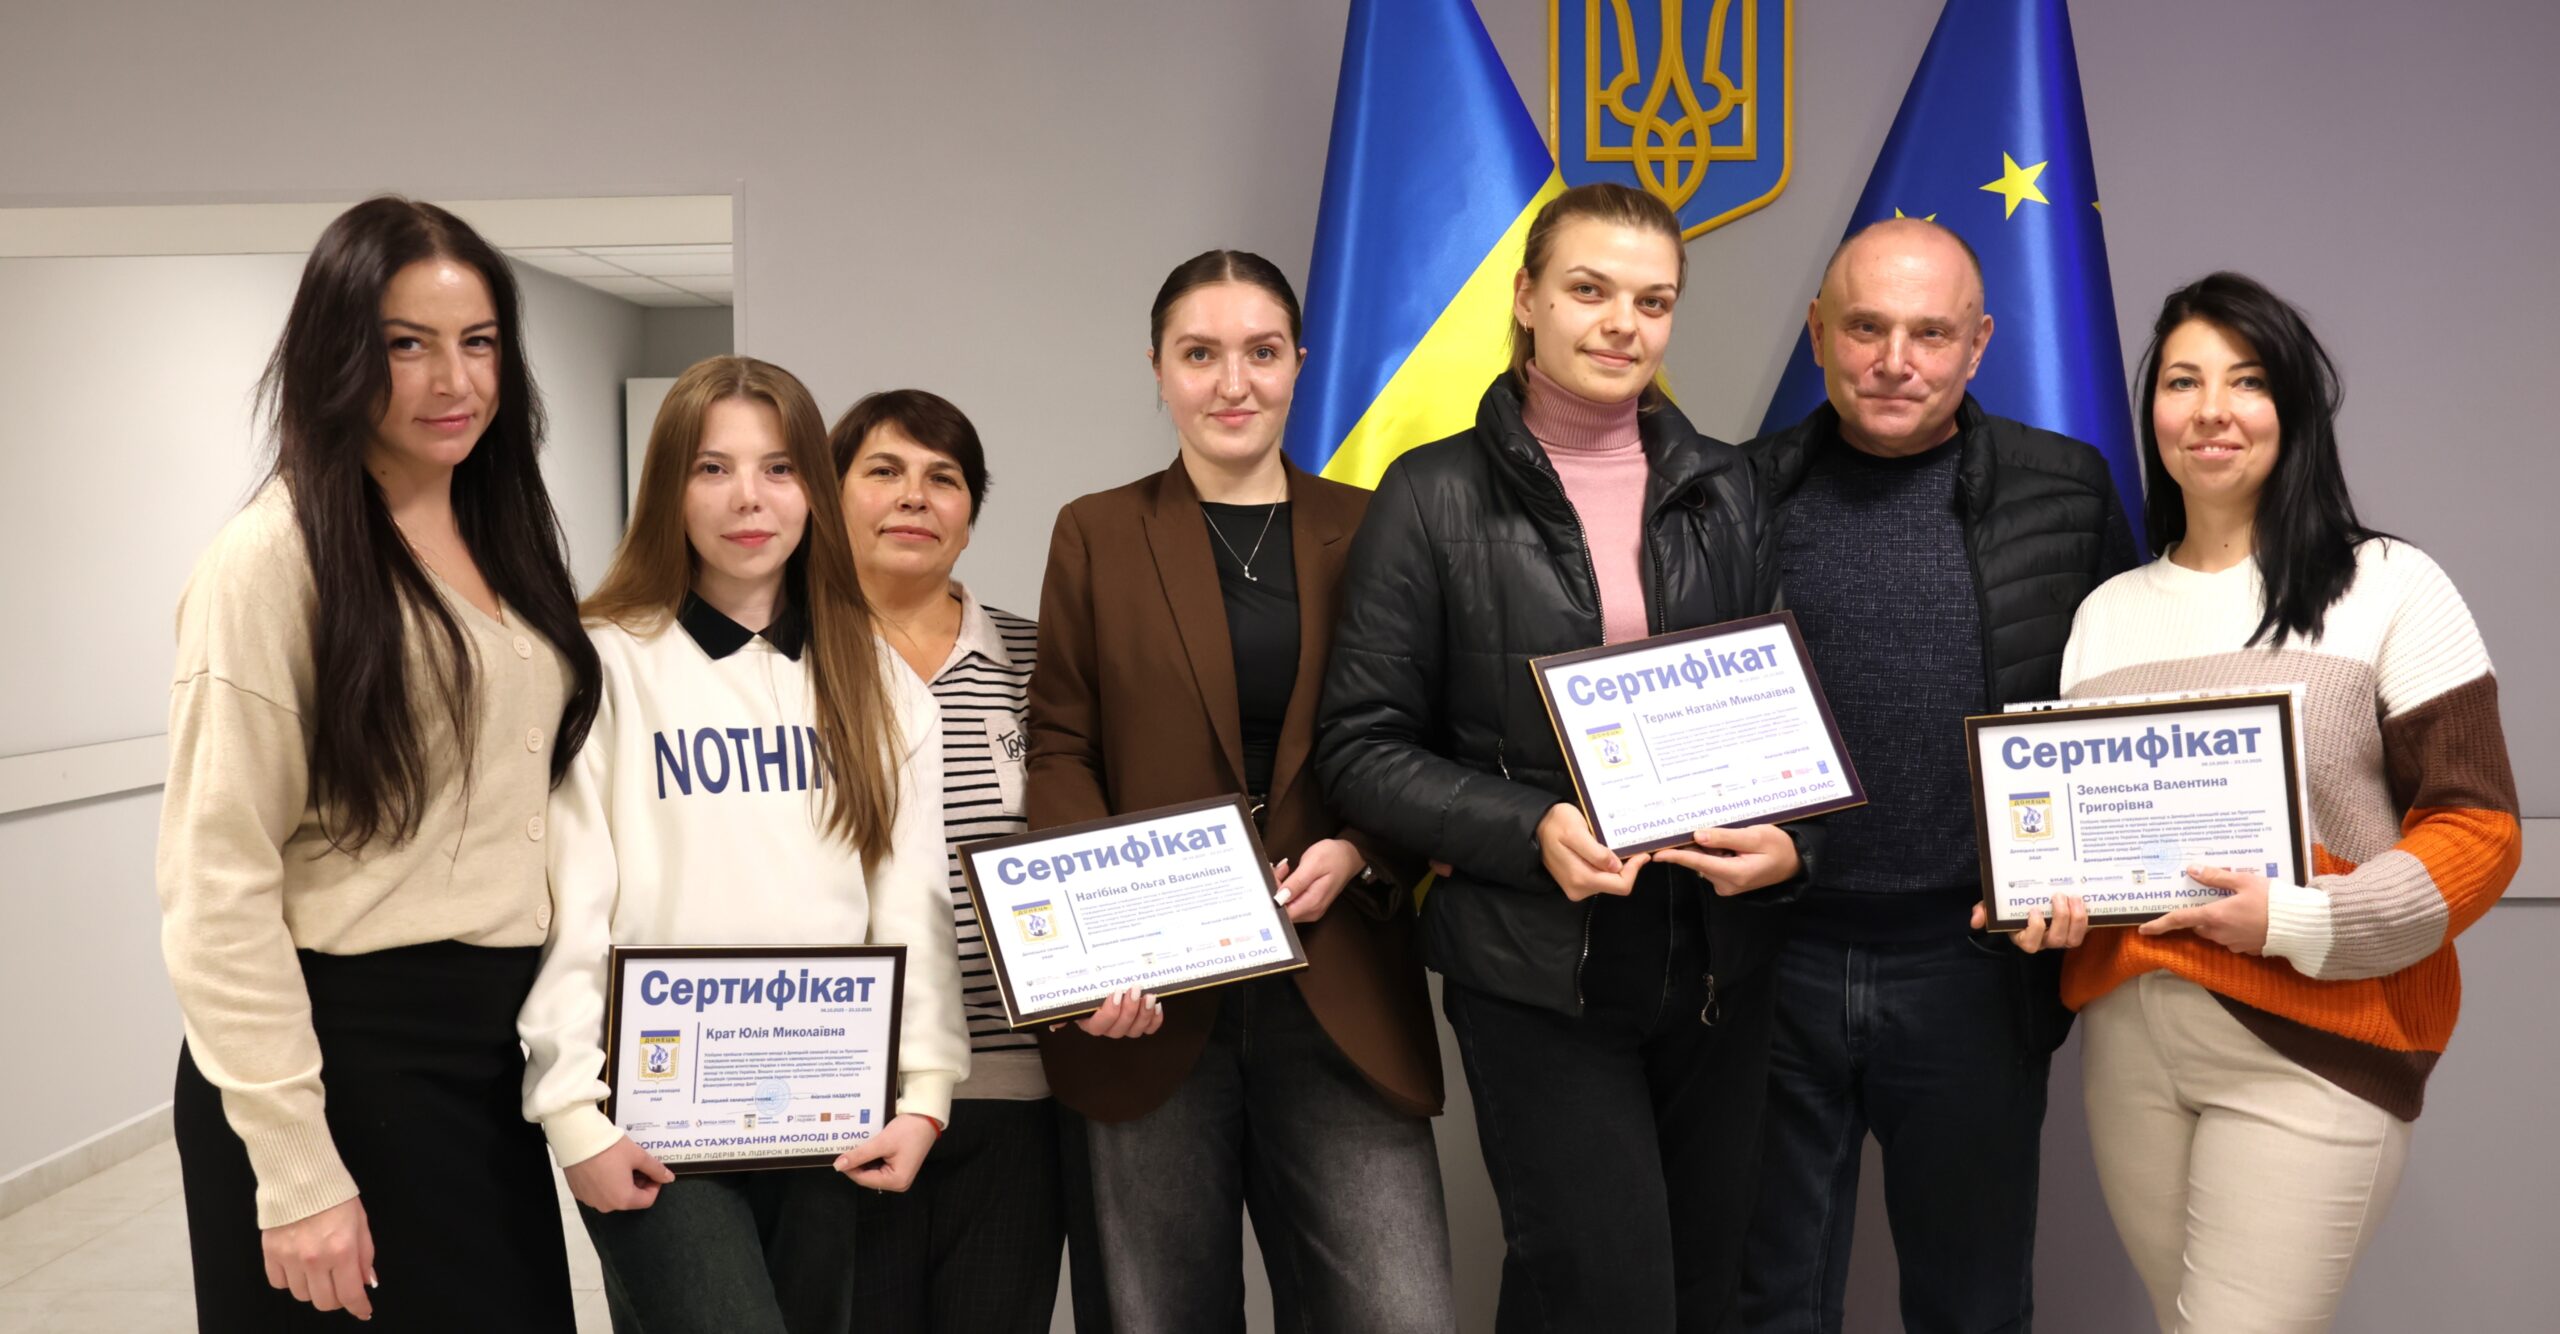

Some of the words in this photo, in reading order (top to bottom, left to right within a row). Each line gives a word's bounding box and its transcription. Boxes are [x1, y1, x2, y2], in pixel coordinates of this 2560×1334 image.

[1567, 644, 1778, 706] Сертифікат
[1642, 710, 1684, 725] Терлик
[1685, 699, 1728, 716] Наталія
[2001, 724, 2262, 775] Сертифікат
[2077, 782, 2150, 796] Зеленська
[2153, 777, 2228, 791] Валентина
[1613, 817, 1675, 837] ПРОГРАМА
[1676, 799, 1751, 822] СТАЖУВАННЯ
[1753, 788, 1798, 805] МОЛОДІ
[1800, 786, 1807, 794] В
[1809, 780, 1835, 792] ОМС
[2078, 800, 2154, 814] Григорівна
[997, 824, 1228, 886] Сертифікат
[1075, 883, 1128, 902] Нагібіна
[1130, 877, 1166, 892] Ольга
[1168, 864, 1232, 884] Василівна
[2009, 897, 2053, 906] ПРОГР
[2082, 890, 2171, 903] СТАЖУВАННЯ
[640, 968, 876, 1013] Сертифікат
[1030, 983, 1098, 1003] ПРОГРАМА
[1100, 965, 1183, 989] СТАЖУВАННЯ
[1185, 955, 1237, 971] МОЛОДІ
[1239, 952, 1246, 960] В
[1248, 946, 1278, 958] ОМС
[706, 1028, 736, 1041] Крат
[739, 1027, 769, 1039] Юлія
[773, 1025, 846, 1038] Миколаївна
[636, 1139, 692, 1150] ОГРАМА
[695, 1135, 777, 1147] СТАЖУВАННЯ
[779, 1132, 829, 1143] МОЛОДІ
[841, 1131, 870, 1140] ОМС
[703, 1151, 735, 1160] ЛІДЕРІВ
[748, 1149, 782, 1157] ЛІДЕРОК
[791, 1146, 834, 1154] ГРОМАДАХ
[836, 1144, 858, 1152] УКРА
